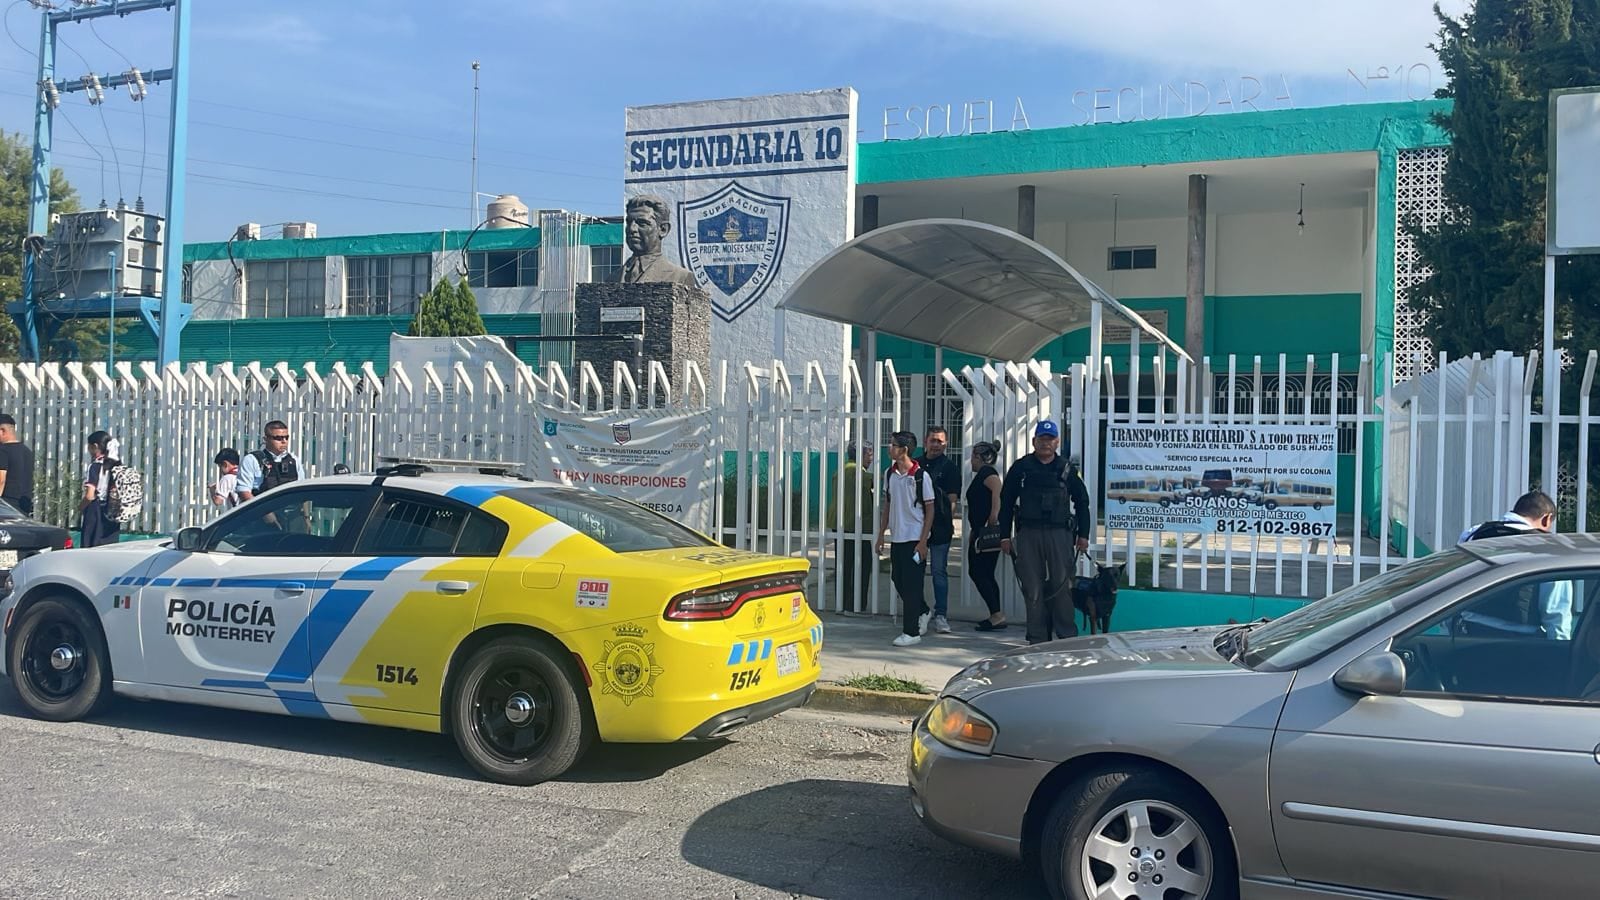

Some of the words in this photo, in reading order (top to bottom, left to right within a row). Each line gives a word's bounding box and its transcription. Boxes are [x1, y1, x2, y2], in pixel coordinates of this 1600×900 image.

[884, 96, 1031, 142] ESCUELA
[630, 130, 804, 172] SECUNDARIA
[816, 126, 842, 160] 10
[688, 232, 708, 286] ESTUDIO
[752, 231, 776, 285] TRIUNFO
[462, 435, 467, 443] 4
[1111, 428, 1188, 442] TRANSPORTES
[1260, 434, 1265, 444] A
[1268, 434, 1293, 444] TODO
[1296, 434, 1320, 444] TREN
[566, 470, 590, 483] HAY
[592, 474, 687, 488] INSCRIPCIONES
[676, 504, 682, 512] A
[1186, 496, 1202, 507] 50
[1207, 495, 1248, 509] AÑOS
[1109, 514, 1164, 523] INSCRIPCIONES
[1166, 516, 1202, 524] ABIERTAS
[1130, 506, 1196, 516] TRASLADANDO
[1198, 509, 1210, 517] EL
[1212, 509, 1250, 518] FUTURO
[1267, 510, 1306, 520] MÉXICO
[1217, 520, 1333, 536] 812-102-9867
[581, 582, 606, 592] 911
[167, 598, 276, 627] POLICÍA
[166, 622, 276, 643] MONTERREY
[376, 664, 419, 686] 1514
[729, 668, 761, 691] 1514
